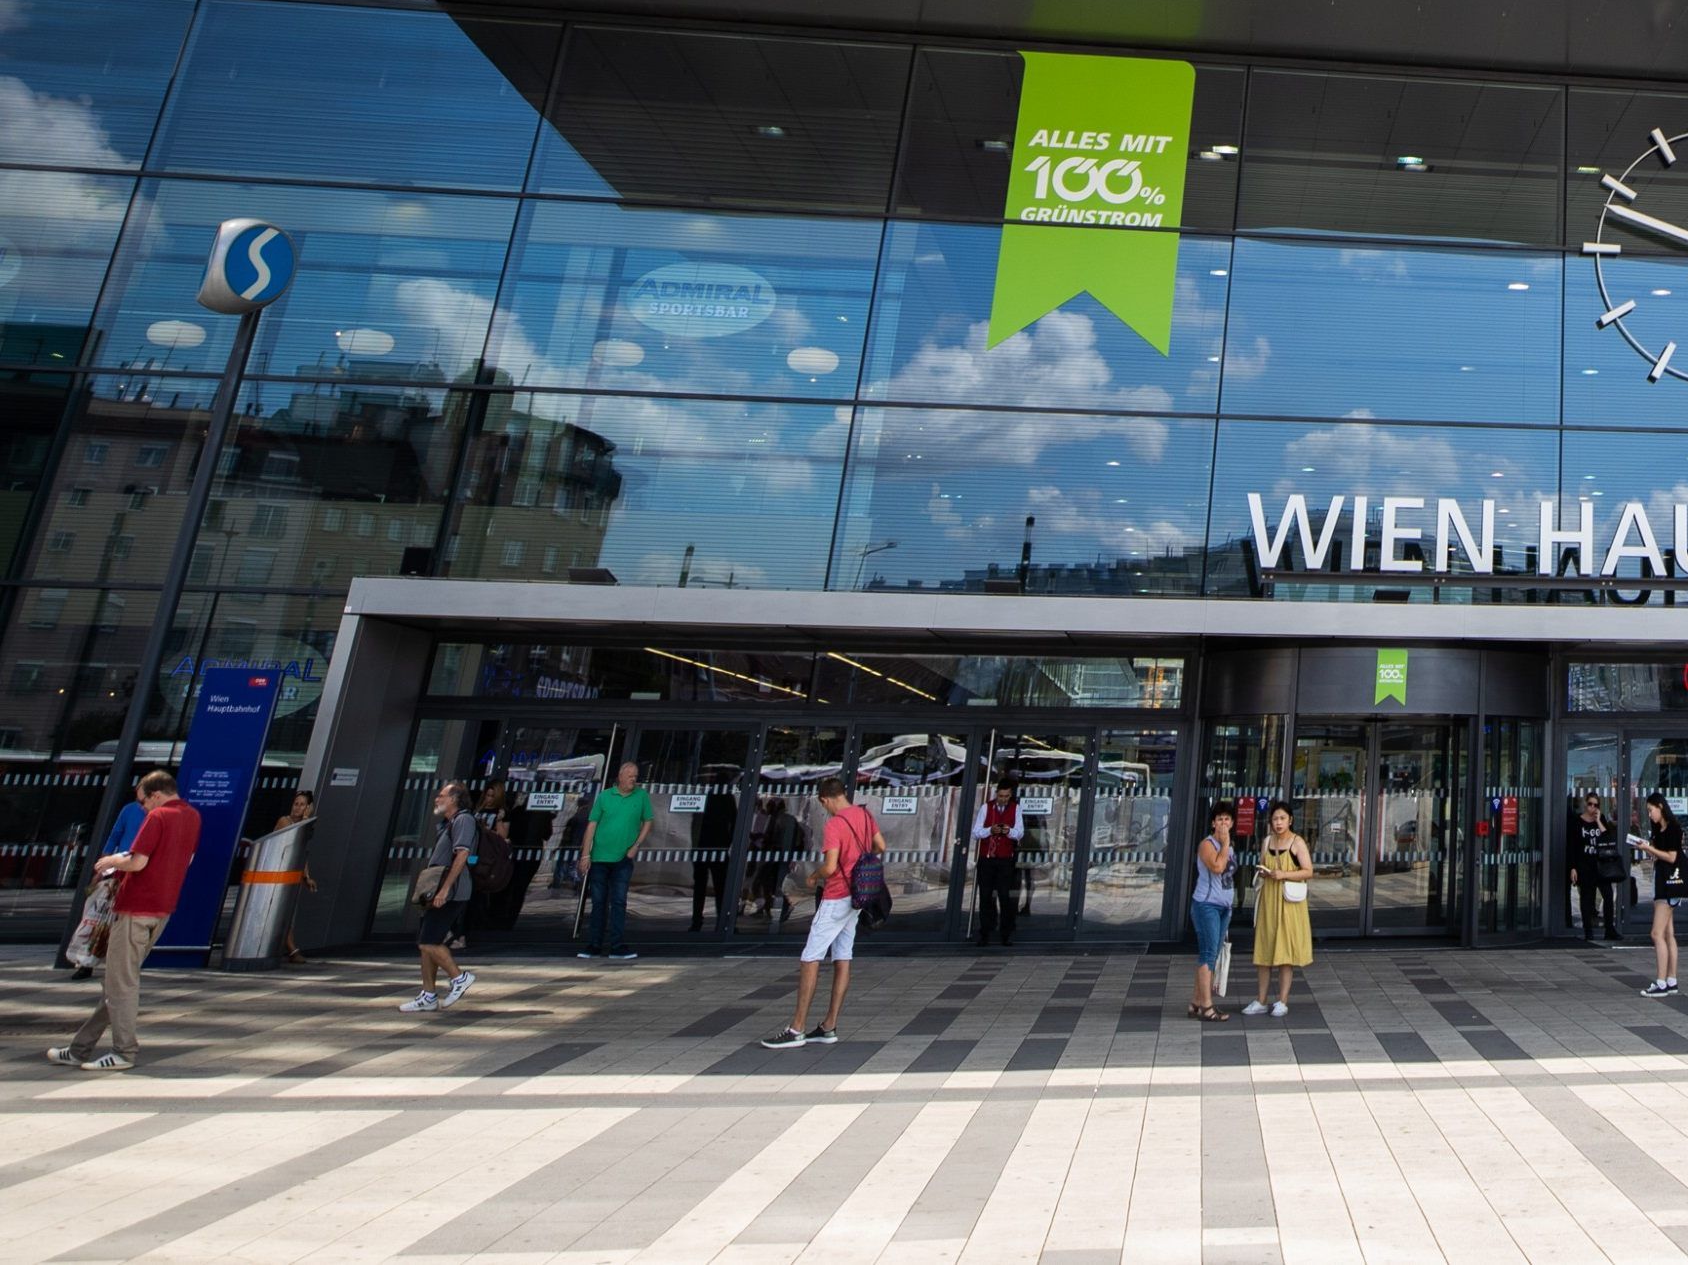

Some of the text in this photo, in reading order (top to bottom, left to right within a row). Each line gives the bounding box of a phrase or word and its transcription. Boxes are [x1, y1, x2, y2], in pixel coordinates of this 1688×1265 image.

[1029, 129, 1173, 154] ALLES MIT
[1024, 156, 1166, 205] 100%
[1020, 206, 1162, 227] GRÜNSTROM
[637, 277, 771, 306] ADMIRAL
[648, 302, 750, 319] SPORTSBAR
[1247, 492, 1496, 575] WIEN
[207, 704, 261, 714] Hauptbahnhof
[210, 695, 230, 703] Wien
